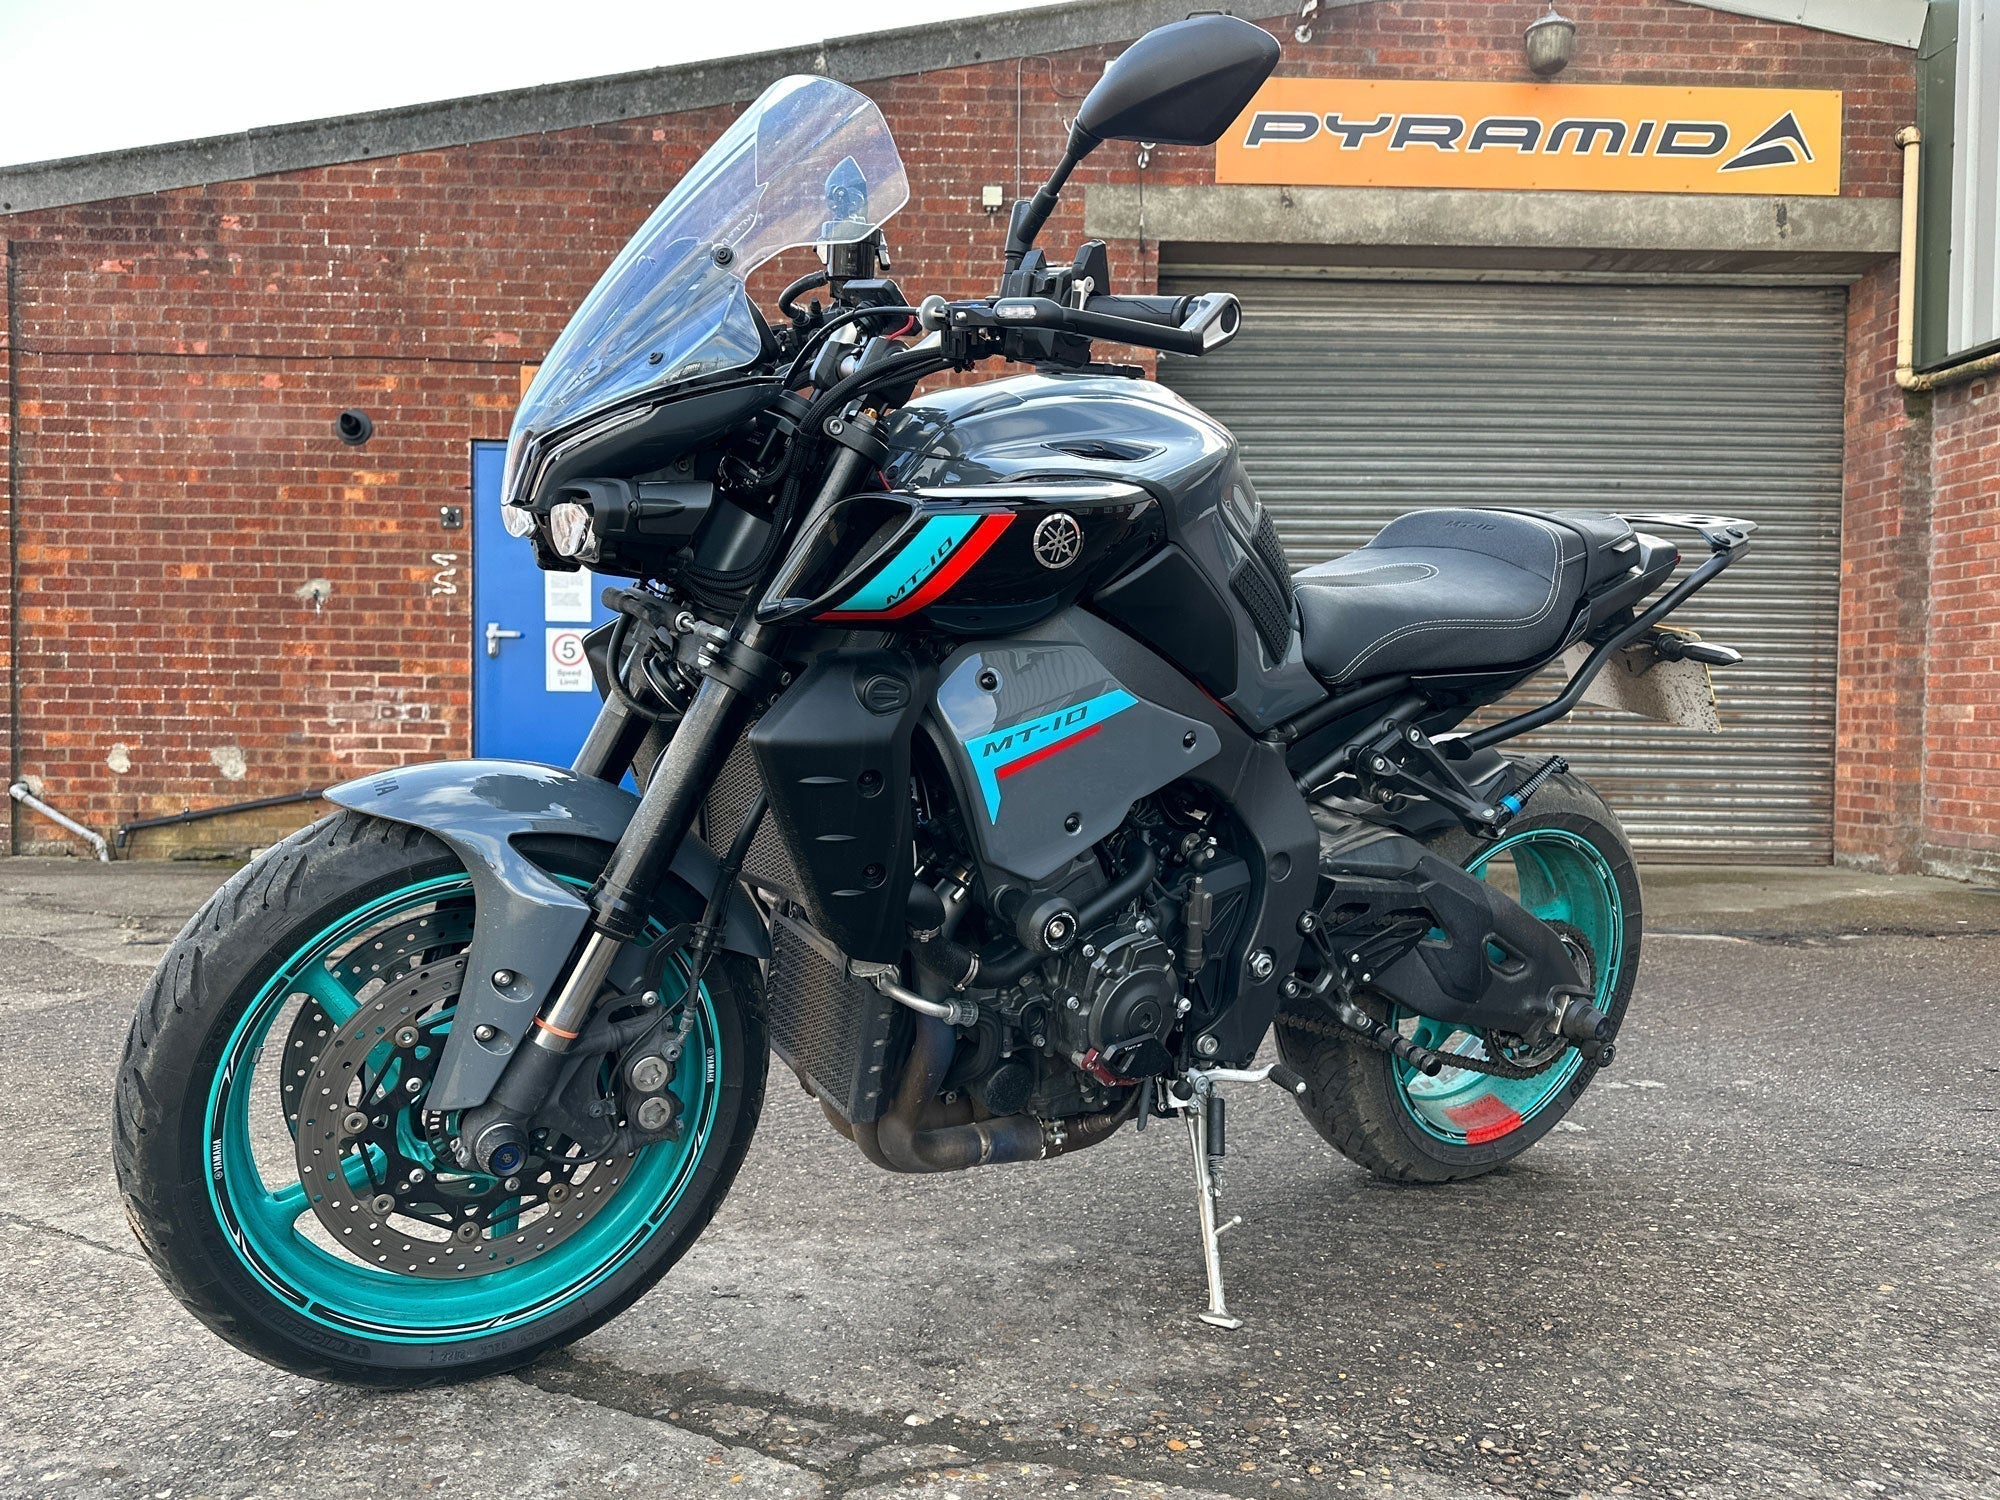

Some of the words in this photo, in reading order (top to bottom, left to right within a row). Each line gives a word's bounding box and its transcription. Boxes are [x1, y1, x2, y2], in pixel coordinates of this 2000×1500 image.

[1243, 111, 1730, 157] PYRAMID
[885, 535, 954, 604] MT-10
[562, 641, 577, 660] 5
[982, 705, 1088, 757] MT-10
[706, 1055, 715, 1084] YAMAHA
[212, 1138, 223, 1173] YAMAHA
